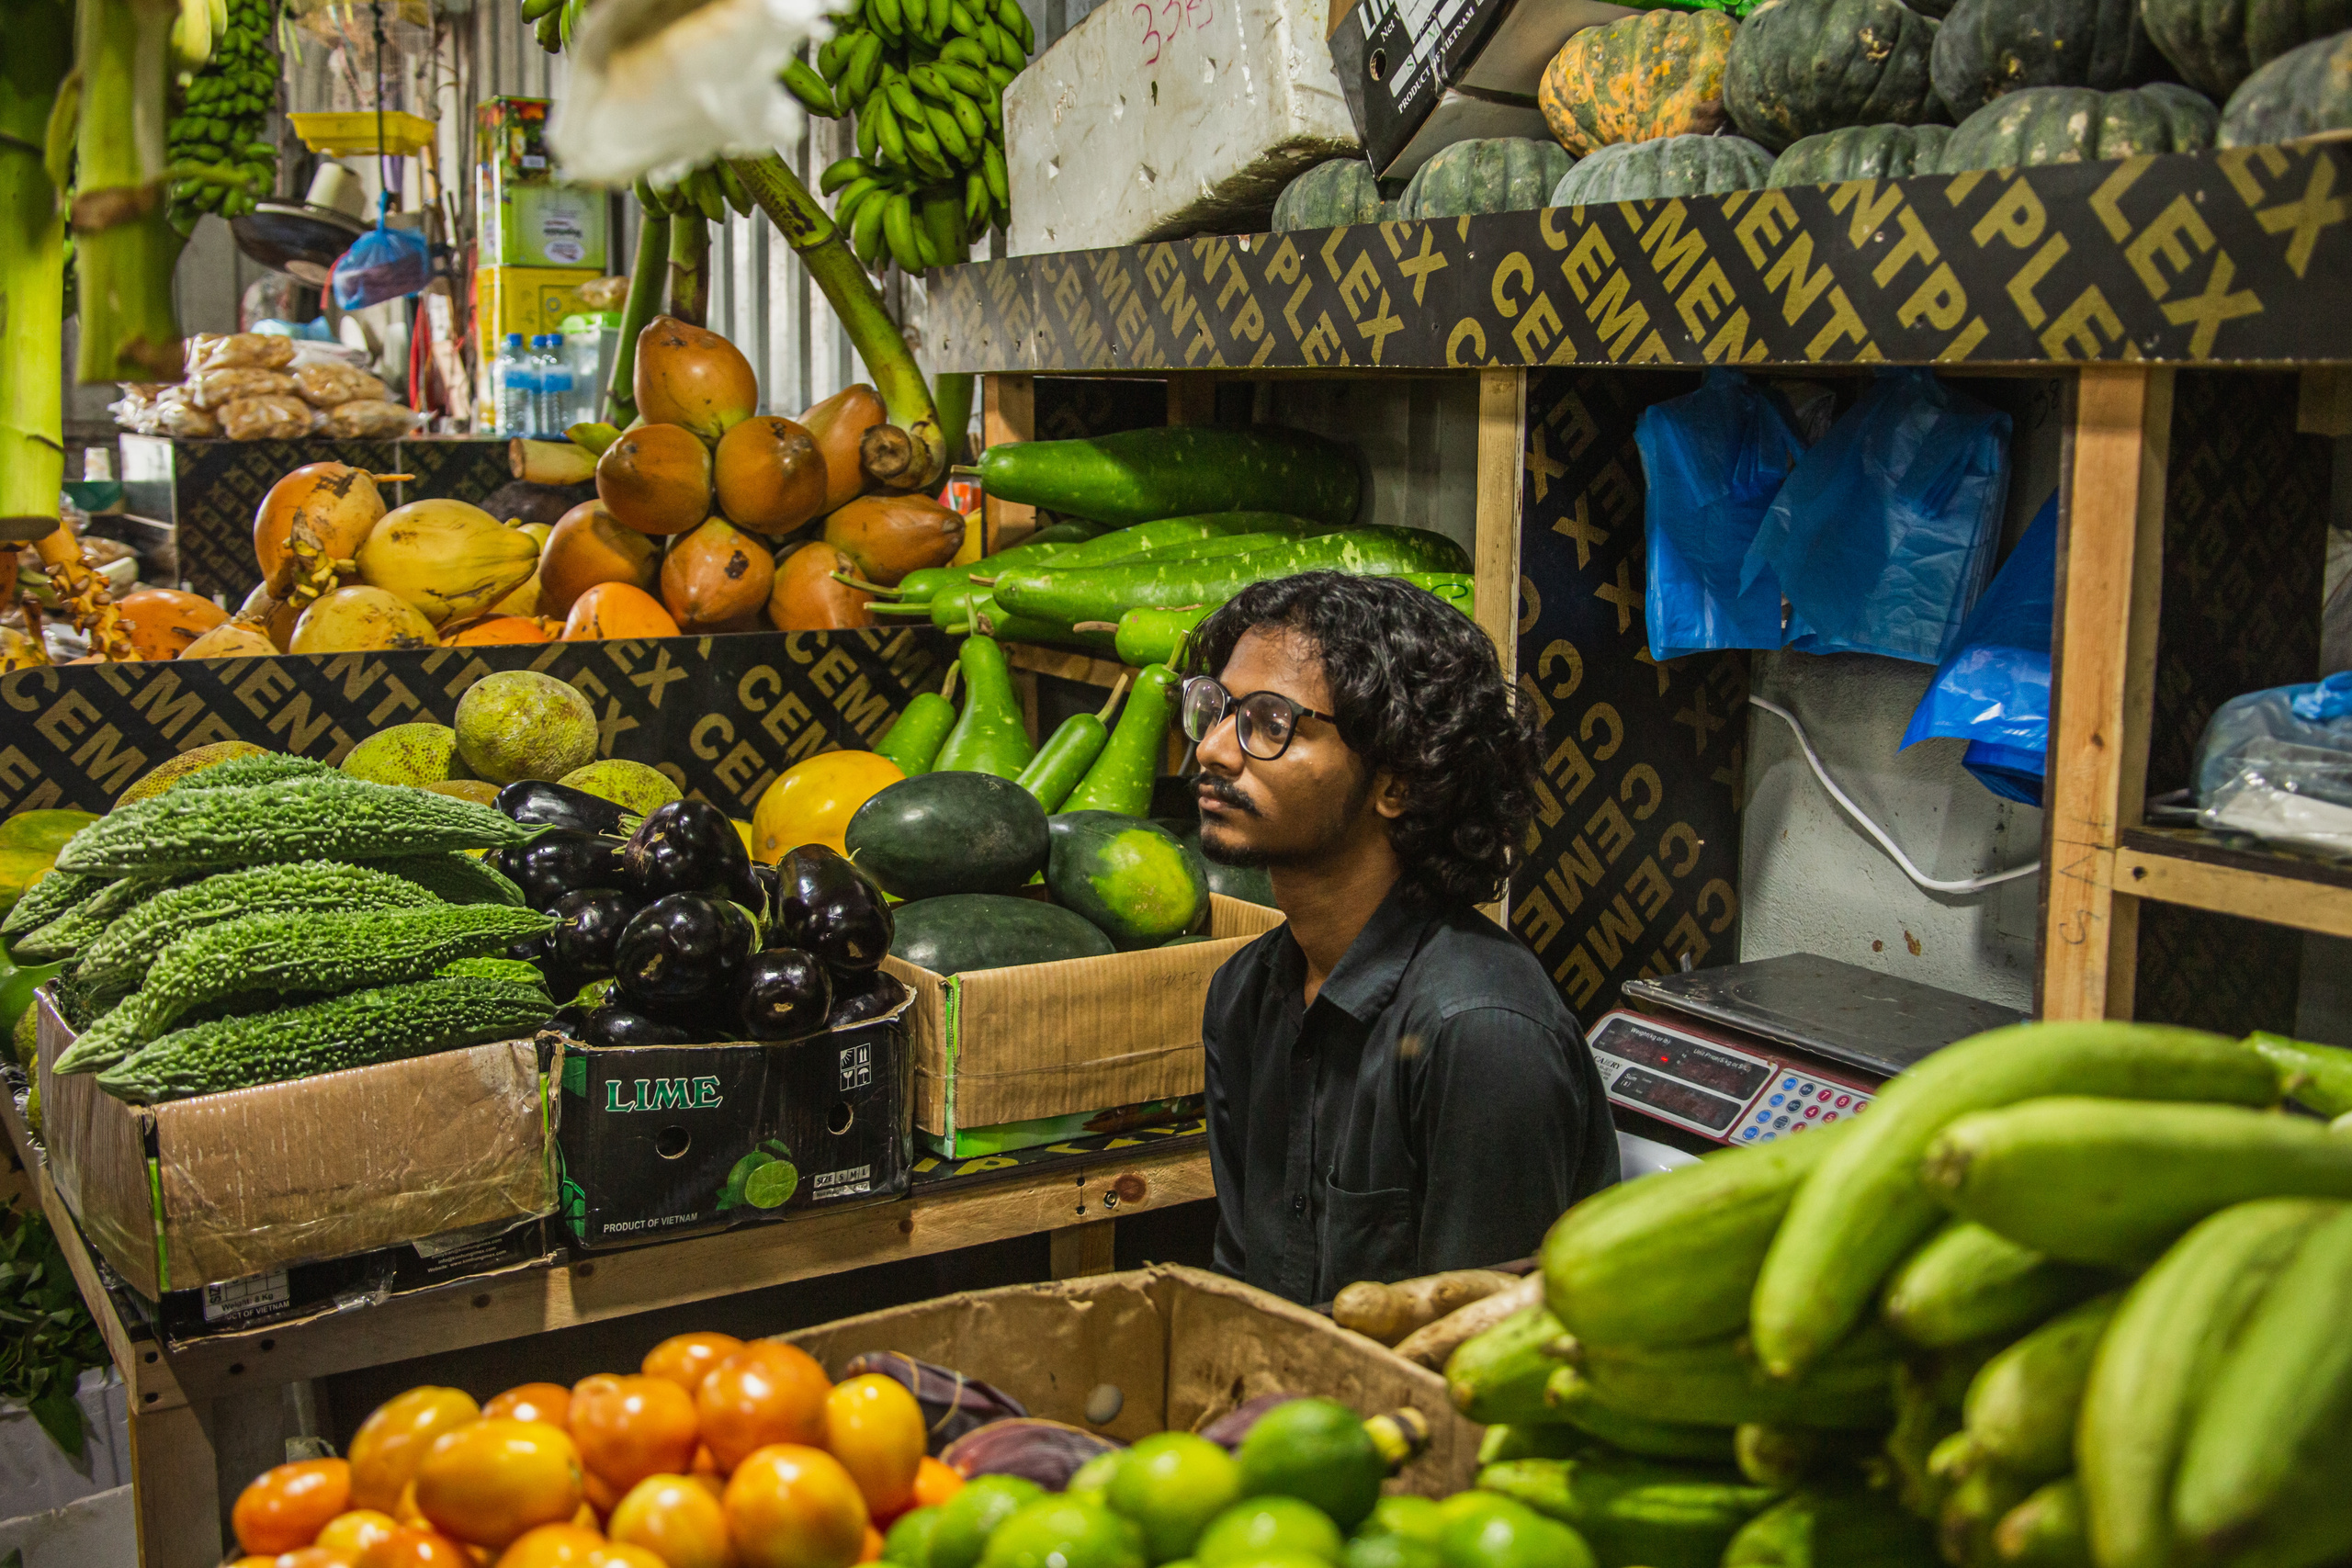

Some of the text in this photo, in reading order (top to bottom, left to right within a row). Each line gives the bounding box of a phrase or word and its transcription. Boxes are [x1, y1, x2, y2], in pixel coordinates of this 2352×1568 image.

[1397, 65, 1431, 115] PRODUCT
[1440, 6, 1476, 55] VIETNAM
[605, 1075, 723, 1112] LIME
[603, 1212, 698, 1234] PRODUCT OF VIETNAM
[209, 1284, 221, 1304] SIZ
[226, 1300, 290, 1321] UCT OF VIETNAM
